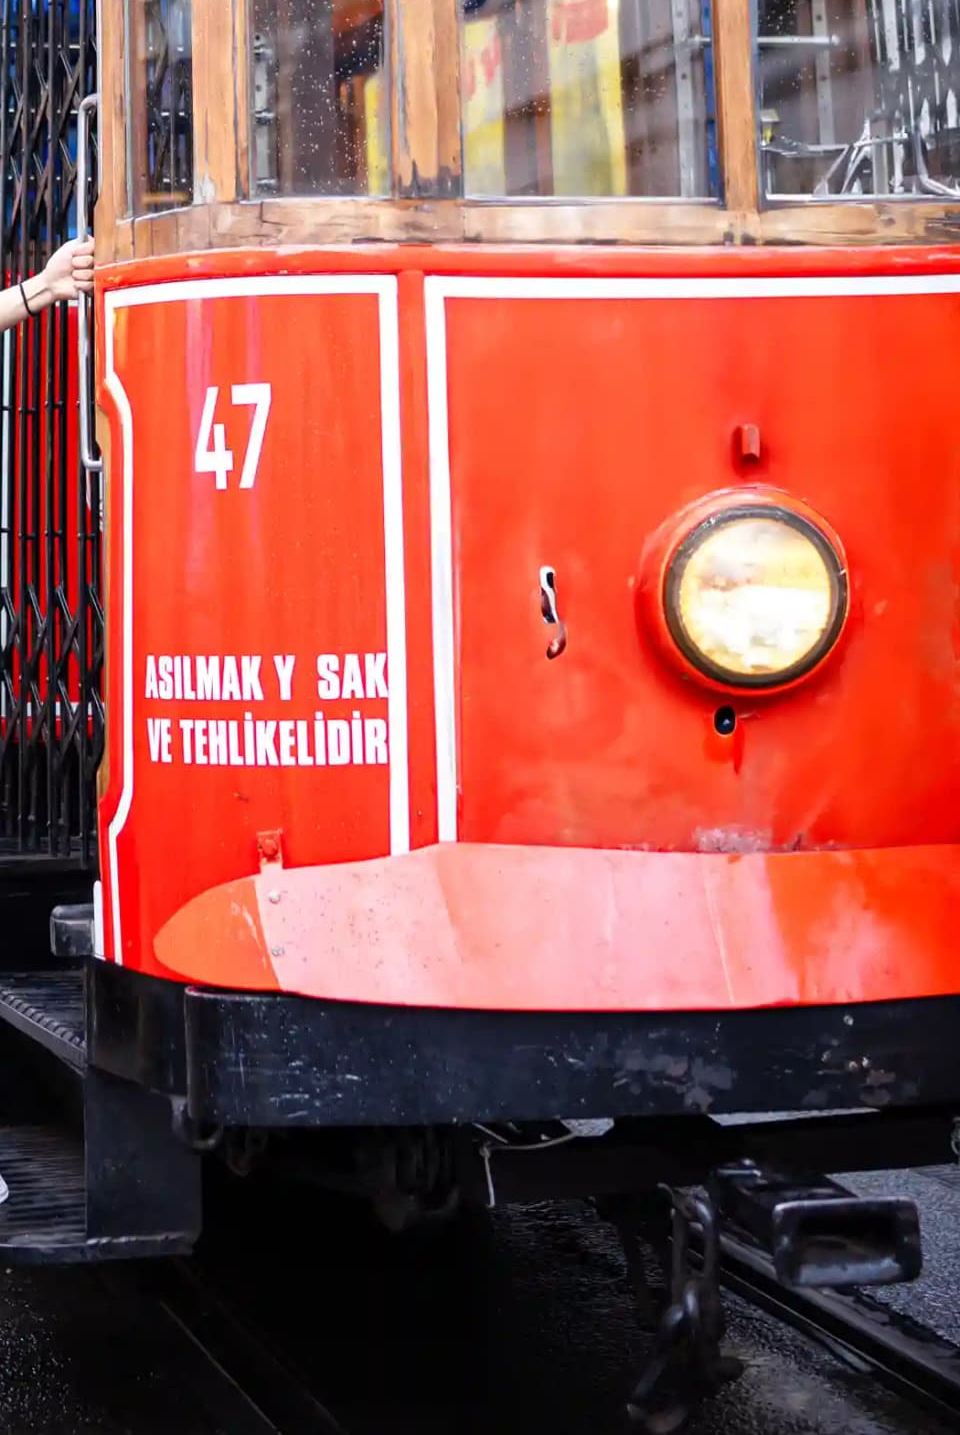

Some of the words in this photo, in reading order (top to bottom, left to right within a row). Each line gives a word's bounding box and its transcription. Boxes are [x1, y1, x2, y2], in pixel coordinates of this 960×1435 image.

[194, 383, 271, 490] 47
[145, 655, 264, 701] ASILMAK
[147, 717, 173, 762] VE
[179, 710, 388, 766] TEHLİKELİDİR
